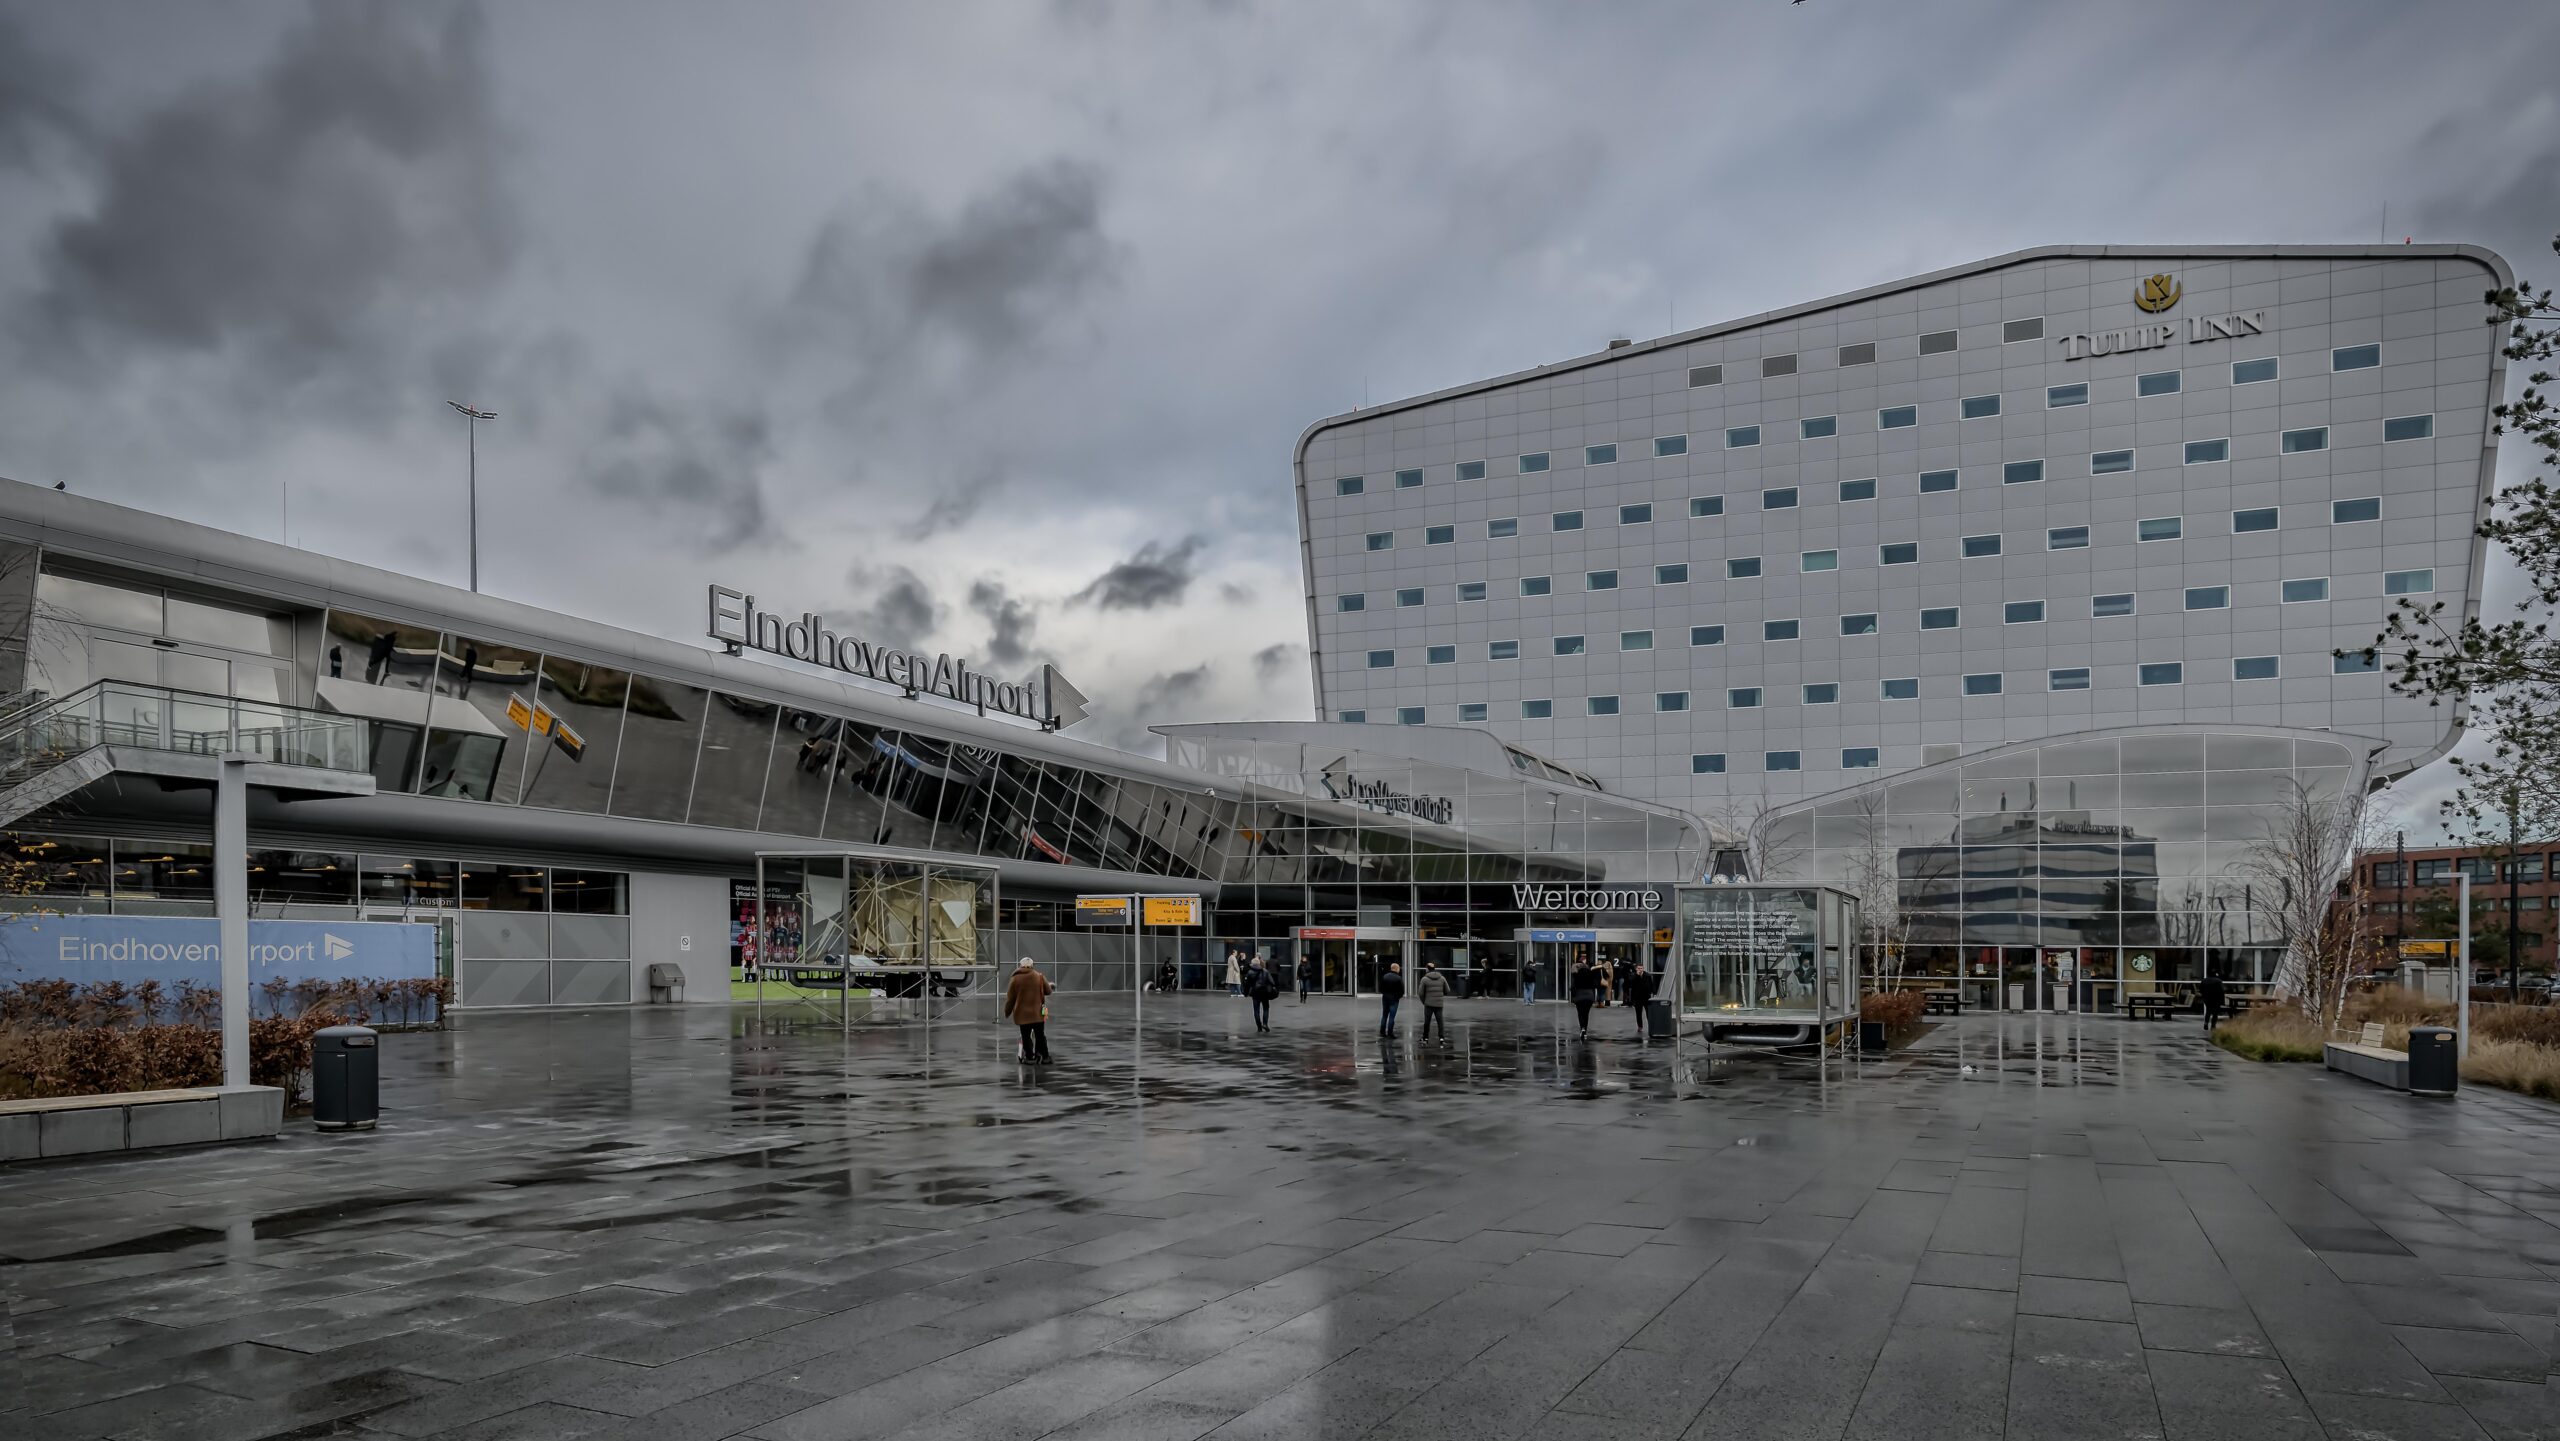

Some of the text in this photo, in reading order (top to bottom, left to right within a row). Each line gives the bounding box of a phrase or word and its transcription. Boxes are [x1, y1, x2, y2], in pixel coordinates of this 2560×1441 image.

[2059, 312, 2264, 361] TULIP INN
[707, 583, 1041, 720] EindhovenAirport
[1513, 884, 1661, 910] Welcome
[58, 935, 315, 966] Eindhovenrport
[1613, 958, 1619, 967] 2
